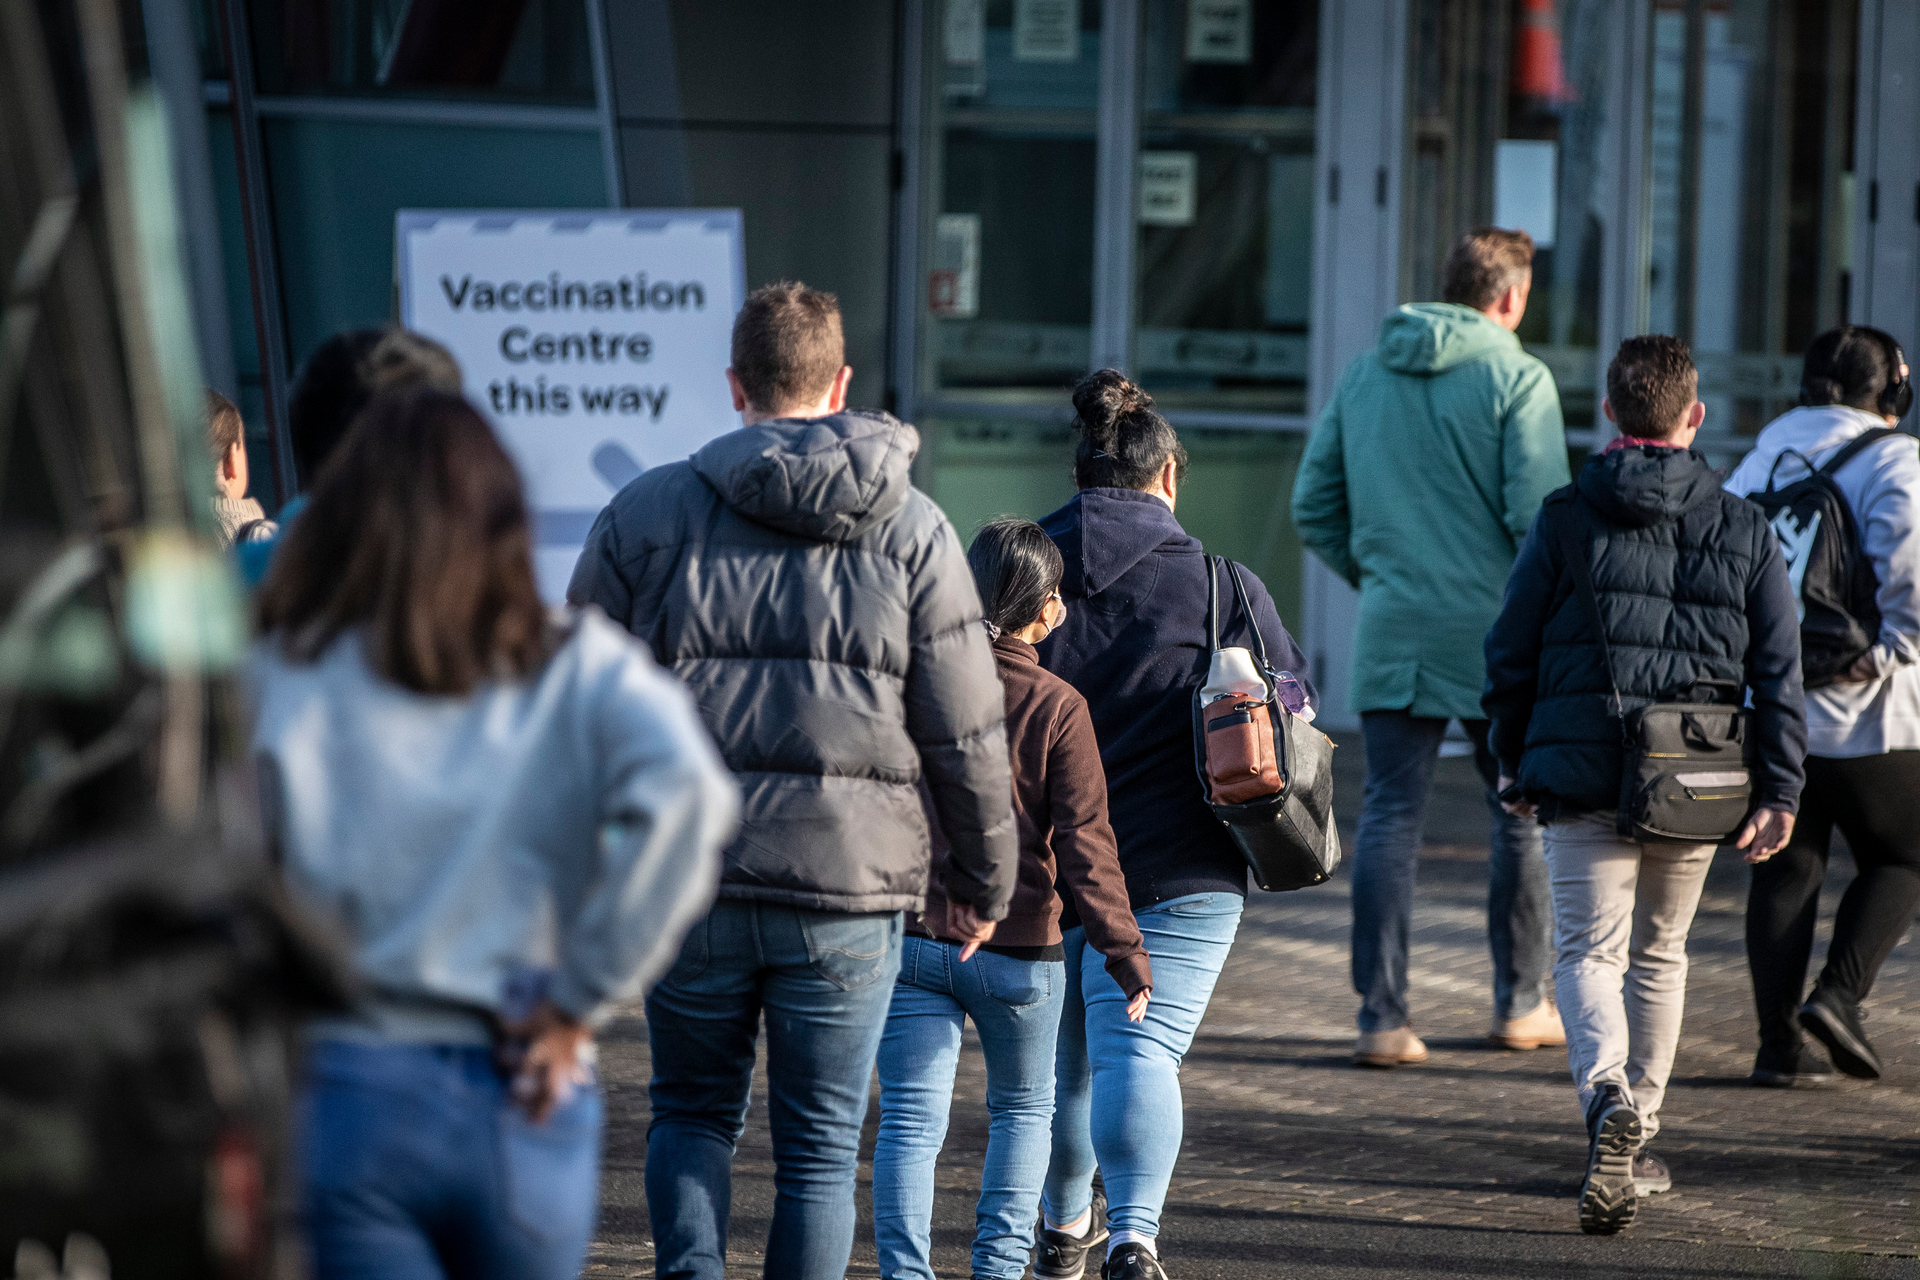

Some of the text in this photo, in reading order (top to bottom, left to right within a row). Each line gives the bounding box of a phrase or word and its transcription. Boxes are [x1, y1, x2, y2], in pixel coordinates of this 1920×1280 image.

[440, 272, 705, 311] Vaccination
[499, 326, 652, 363] Centre
[488, 377, 669, 421] this way
